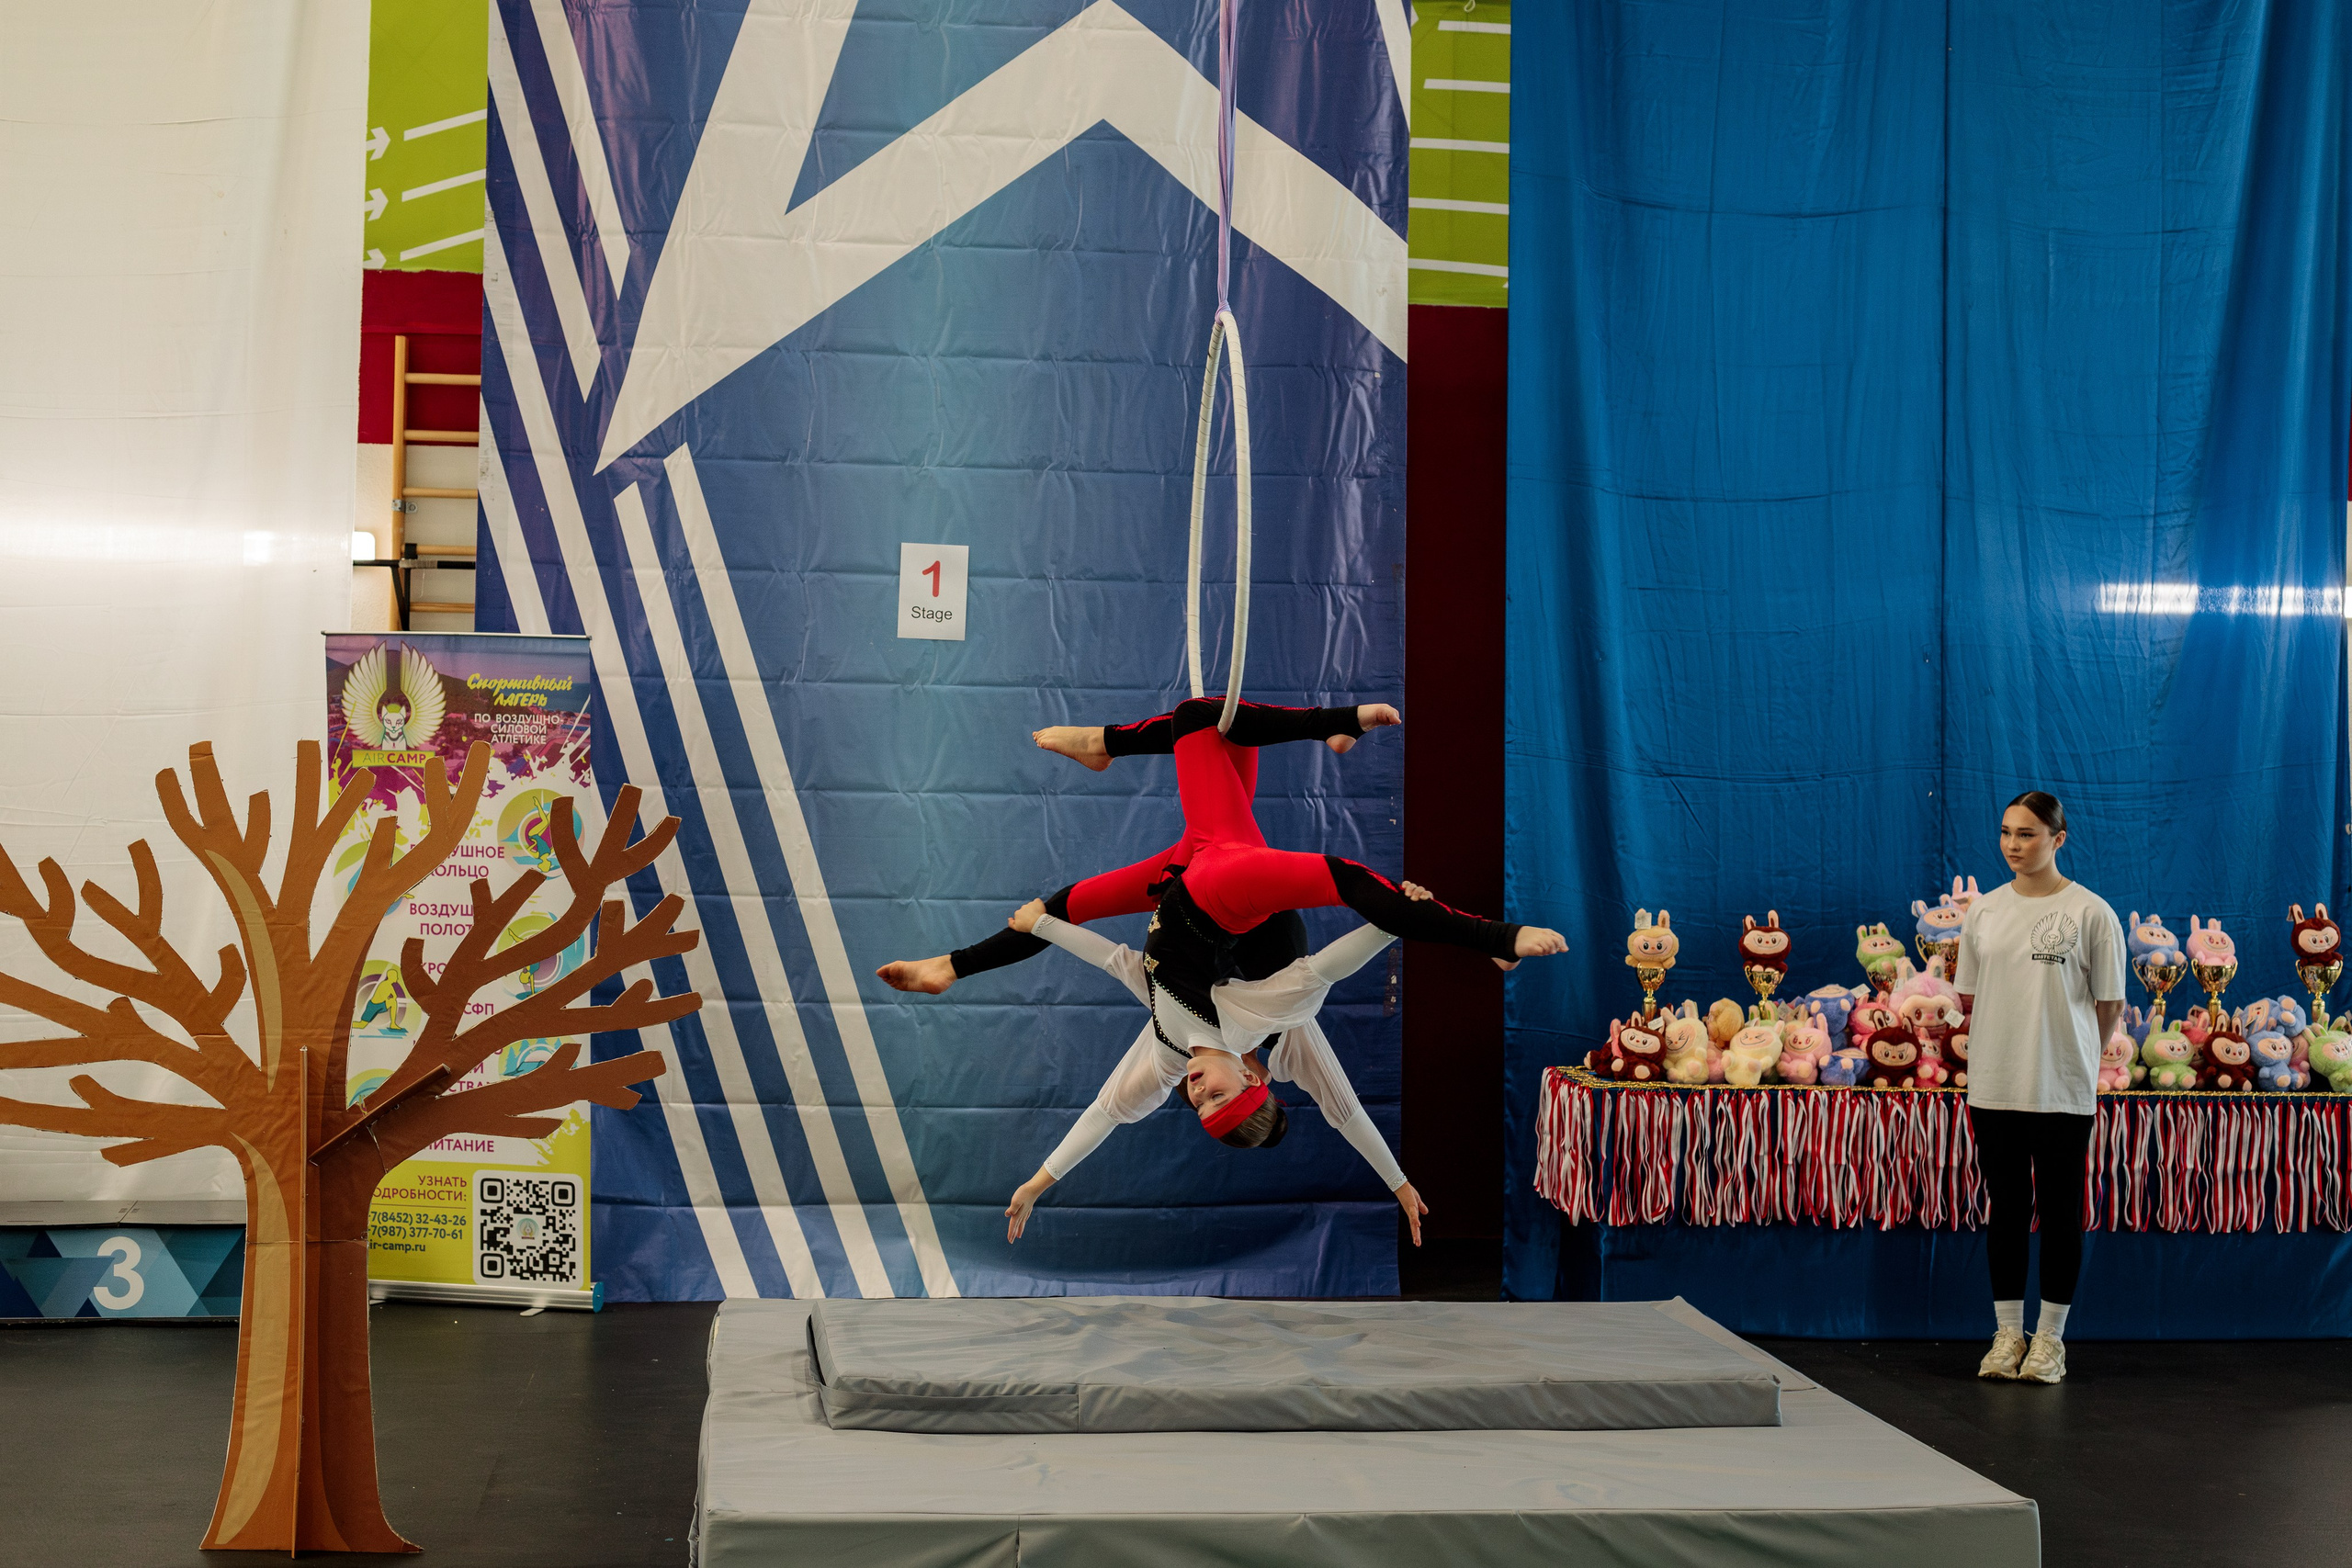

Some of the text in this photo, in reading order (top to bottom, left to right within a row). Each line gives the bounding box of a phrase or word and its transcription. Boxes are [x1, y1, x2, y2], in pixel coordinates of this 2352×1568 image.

[922, 560, 941, 598] 1
[910, 605, 953, 623] Stage
[467, 672, 573, 697] Спортивный
[493, 693, 548, 707] ЛАГЕРЬ
[474, 713, 564, 726] ПО ВОЗДУШНО-
[490, 723, 548, 734] СИЛОВОЙ
[491, 734, 548, 745] АТЛЕТИКЕ
[431, 864, 489, 878] ОЛЬЦО
[426, 1139, 494, 1153] ИТАНИЕ
[417, 1175, 468, 1188] УЗНАТЬ
[373, 1187, 467, 1201] ОДРОБНОСТИ:
[368, 1211, 467, 1226] 7(8452) 32-43-26
[409, 1226, 463, 1240] 377-70-61
[369, 1239, 426, 1254] ir-camp.ru
[93, 1235, 145, 1311] 3
